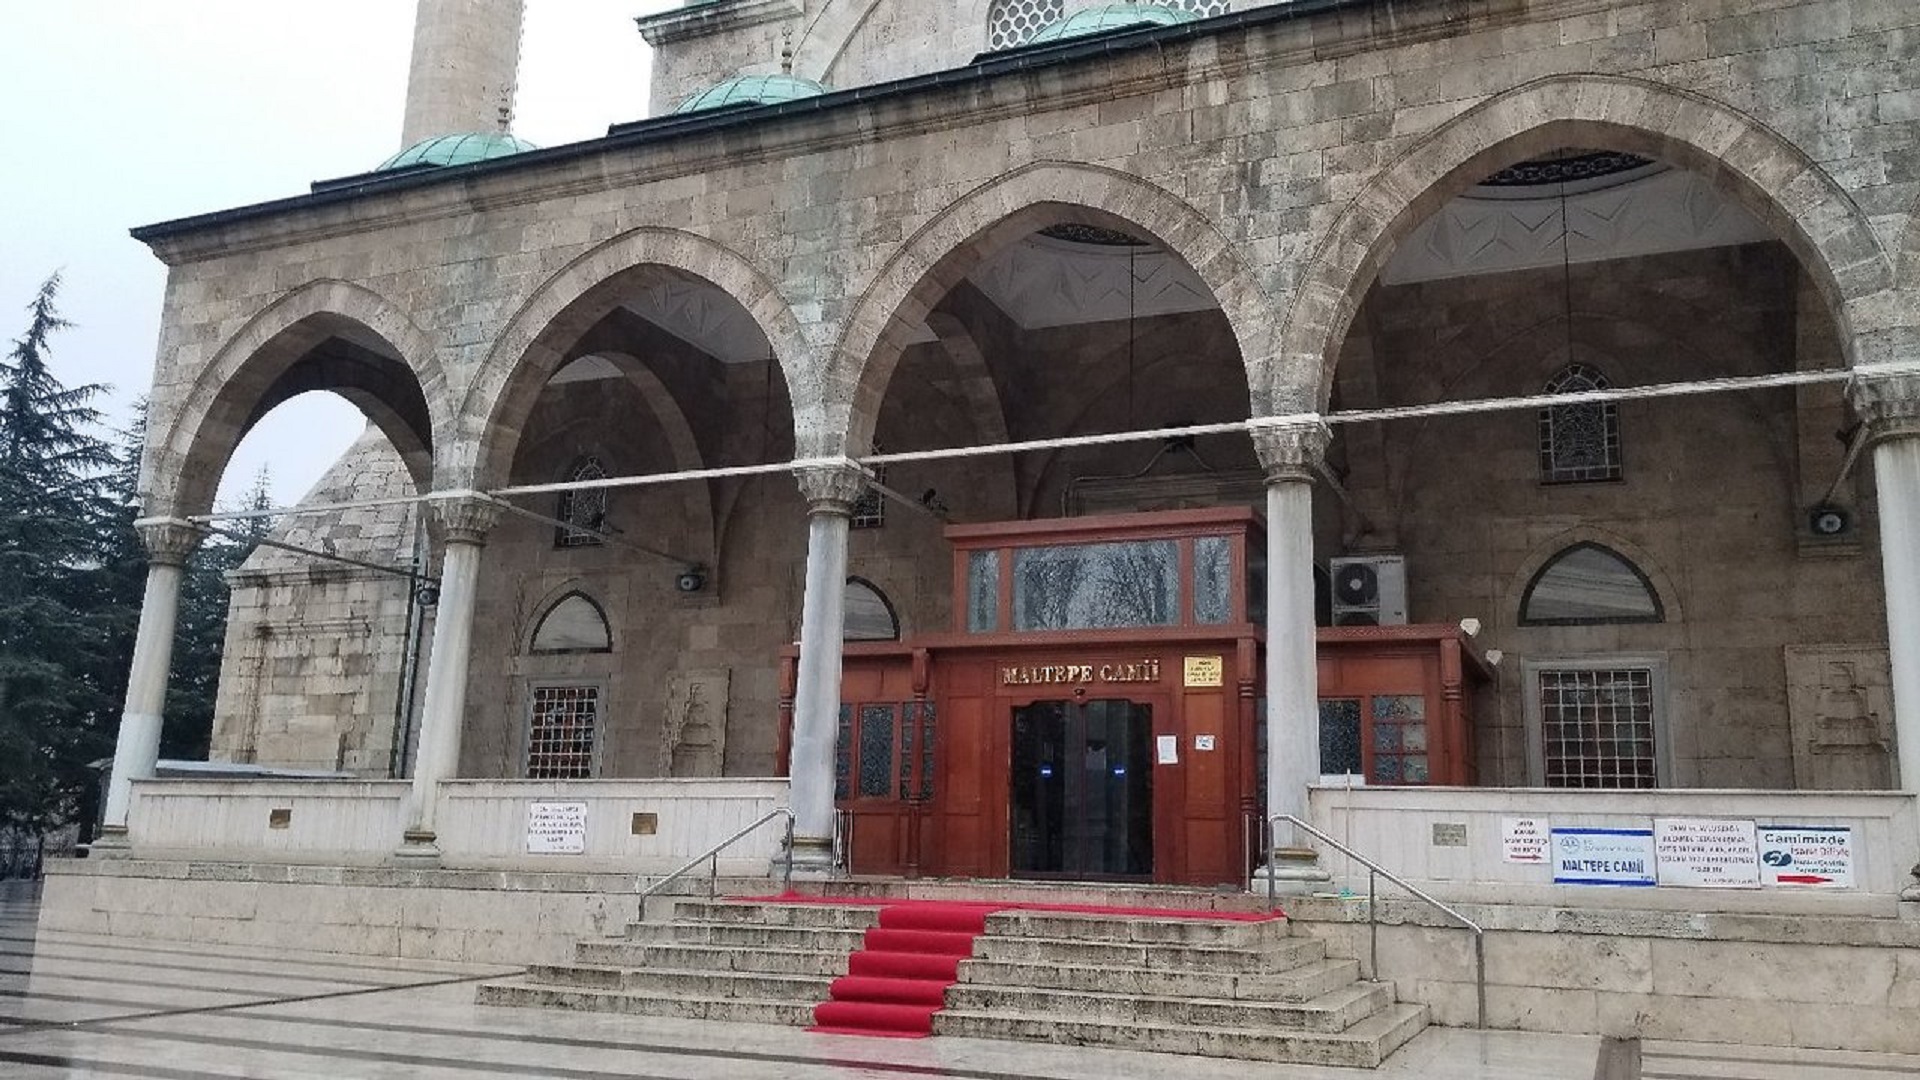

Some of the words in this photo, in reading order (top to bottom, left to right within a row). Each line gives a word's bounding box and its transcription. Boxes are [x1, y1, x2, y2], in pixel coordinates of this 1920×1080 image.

[1003, 664, 1093, 685] MALTEPE
[1764, 833, 1846, 846] Camimizde
[1562, 859, 1611, 873] MALTEPE
